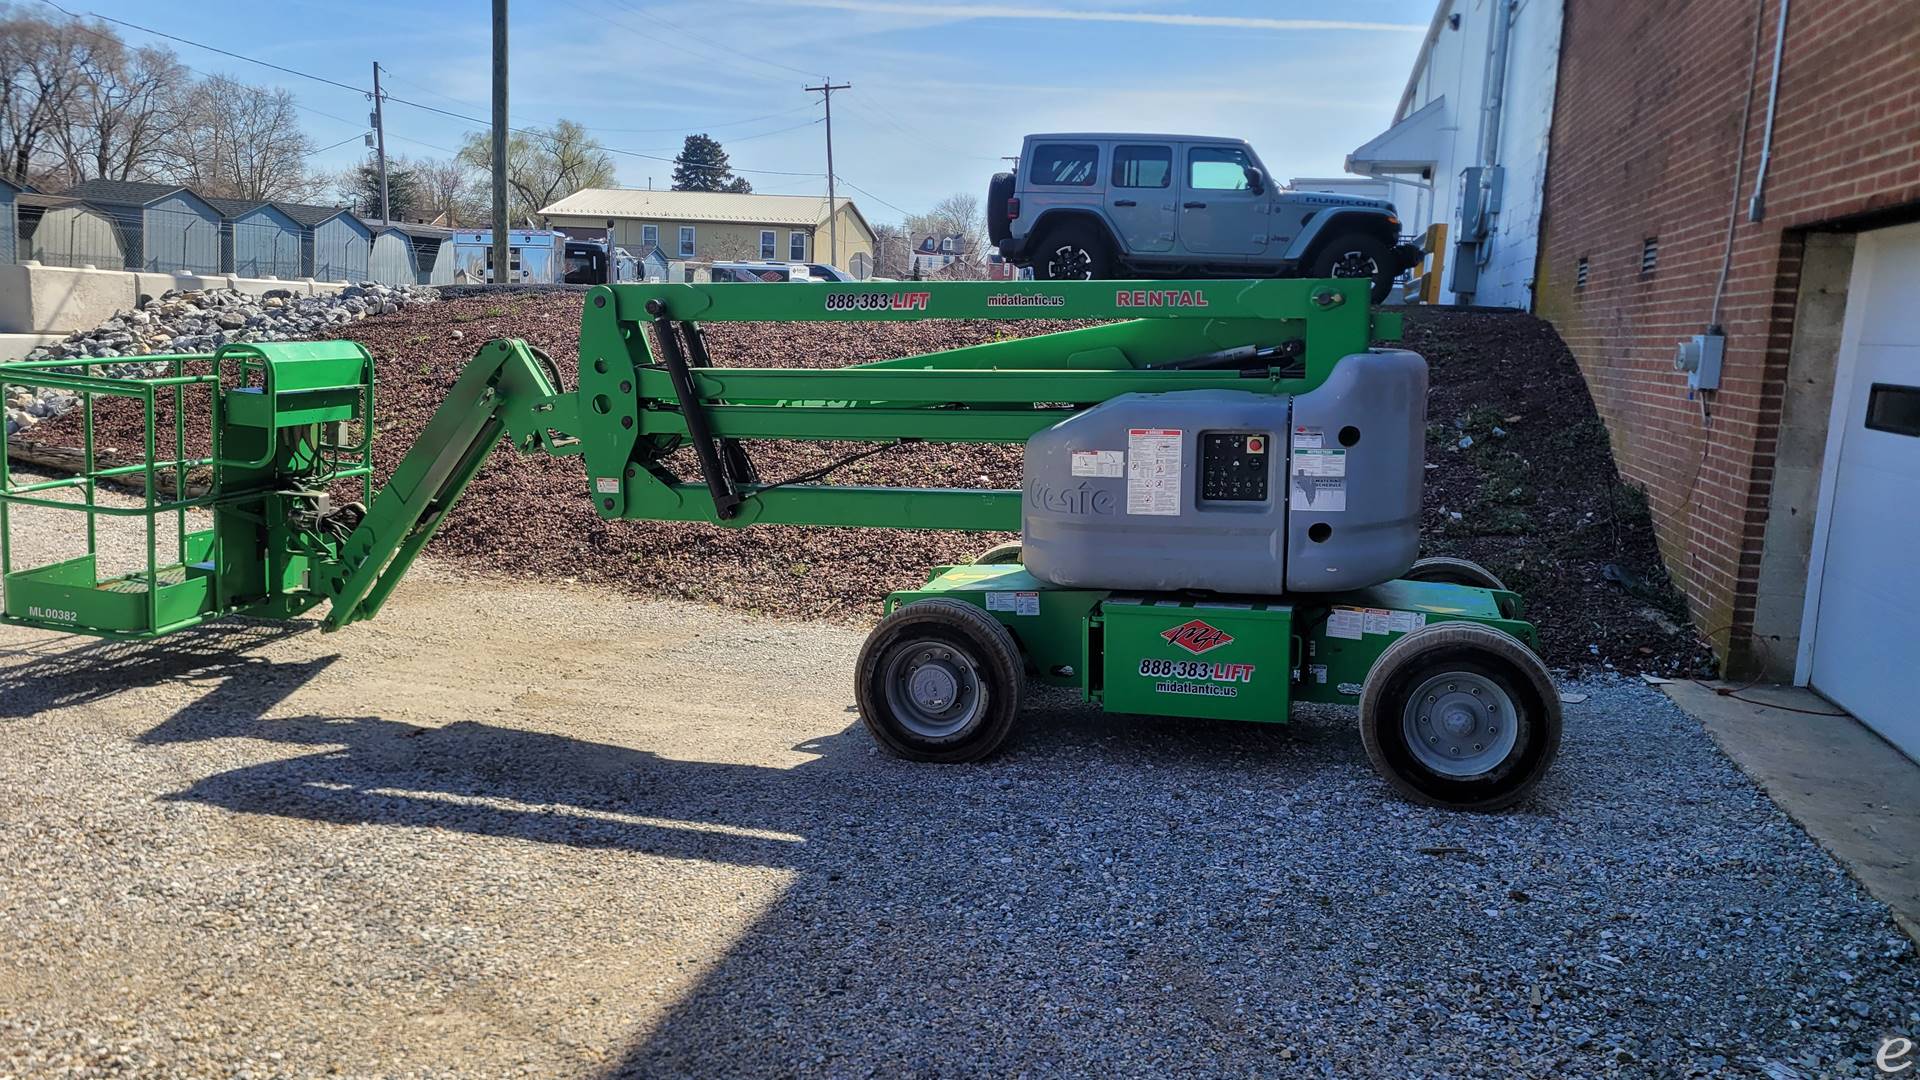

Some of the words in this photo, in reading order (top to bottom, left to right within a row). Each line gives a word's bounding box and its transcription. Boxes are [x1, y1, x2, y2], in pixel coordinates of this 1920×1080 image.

[1306, 196, 1378, 208] RUBICON
[988, 294, 1064, 306] midatlantic.us
[1116, 291, 1208, 307] RENTAL
[29, 606, 77, 622] ML00382
[1156, 681, 1237, 697] midatlantic.us
